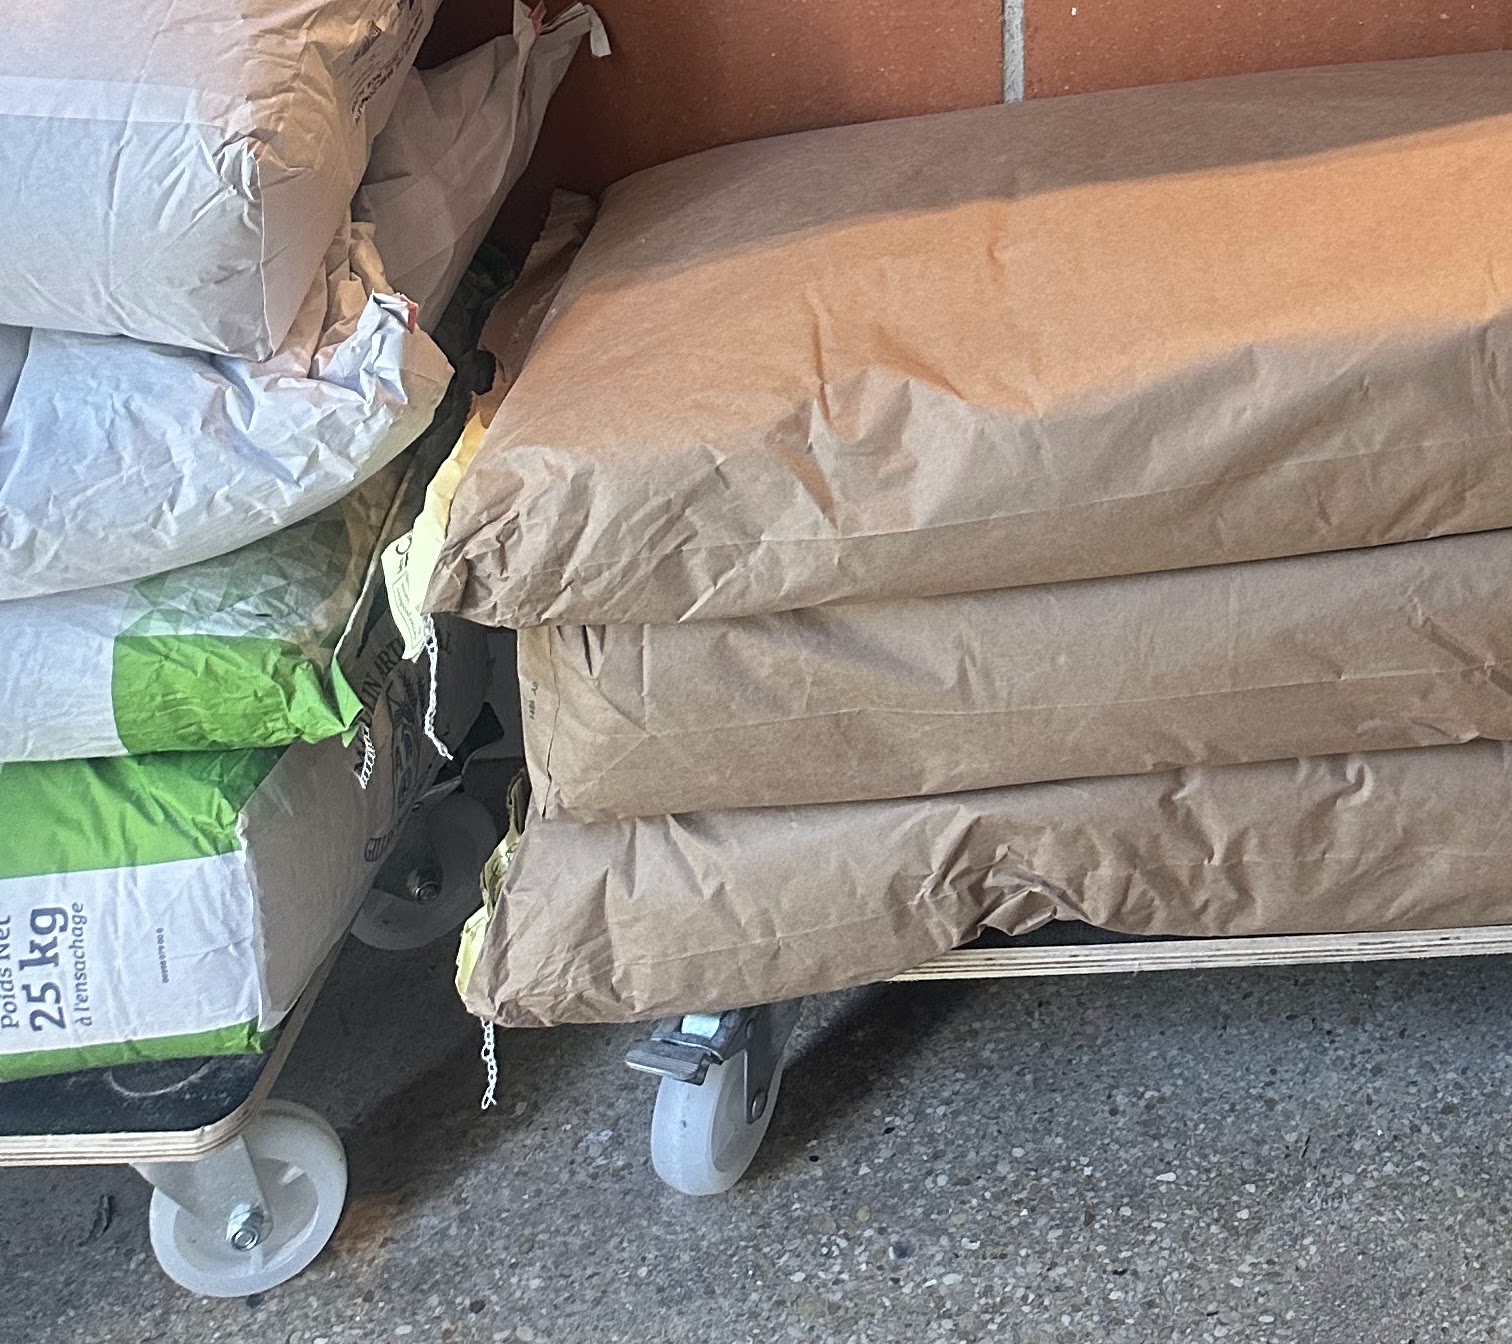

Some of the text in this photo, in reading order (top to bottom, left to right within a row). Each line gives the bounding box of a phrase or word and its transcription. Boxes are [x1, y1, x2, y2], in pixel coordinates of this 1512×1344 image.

[0, 967, 20, 1030] Poids
[18, 906, 70, 1032] 25 kg
[68, 901, 93, 1027] à l'ensachage
